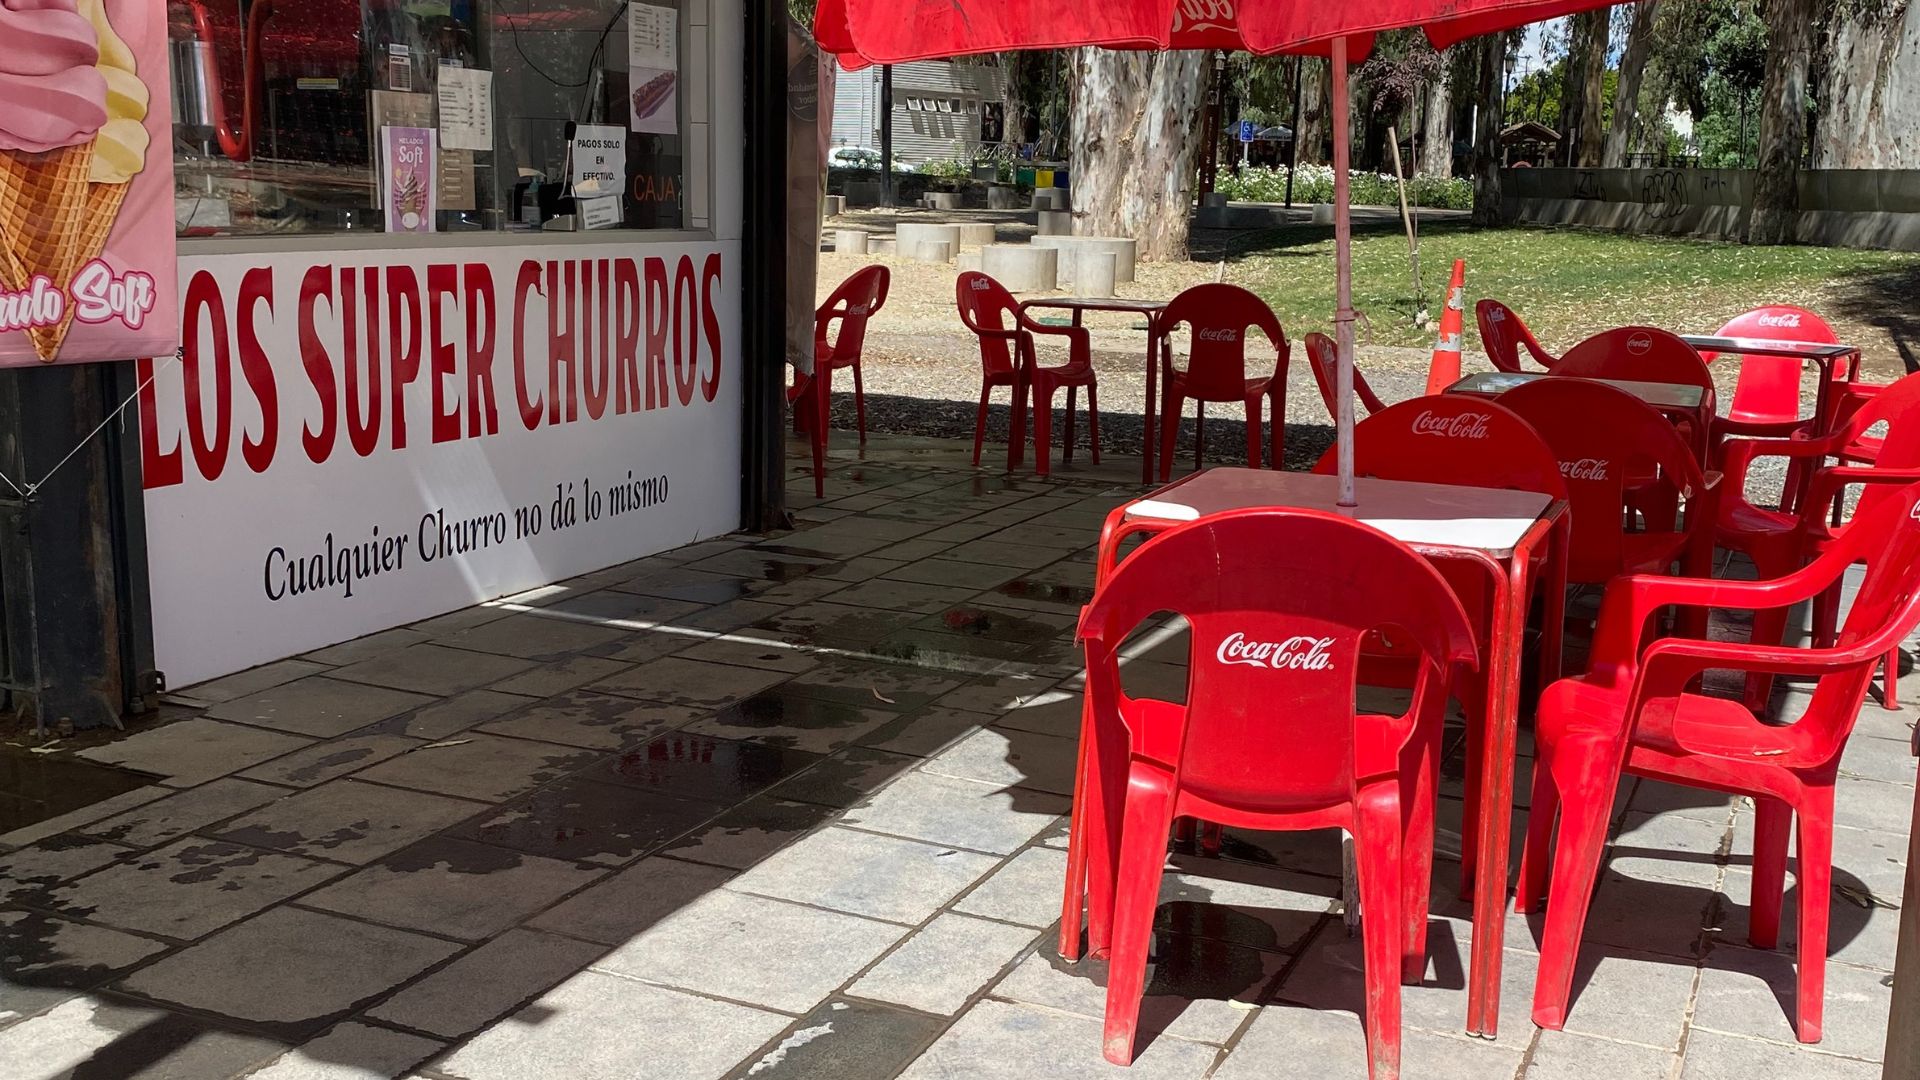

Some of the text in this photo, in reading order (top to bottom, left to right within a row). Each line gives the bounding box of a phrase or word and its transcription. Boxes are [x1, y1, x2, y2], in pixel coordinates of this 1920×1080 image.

[398, 146, 424, 168] Soft
[577, 139, 620, 149] PAGOS SOLO
[595, 156, 605, 165] EN
[582, 171, 616, 181] EFECTIVO.
[634, 174, 676, 202] CAJA
[71, 261, 153, 327] Soft
[135, 252, 722, 489] LOS SUPER CHURROS
[264, 470, 669, 602] Cualquier Churro no dá lo mismo
[1216, 631, 1337, 671] Coca-Cola
